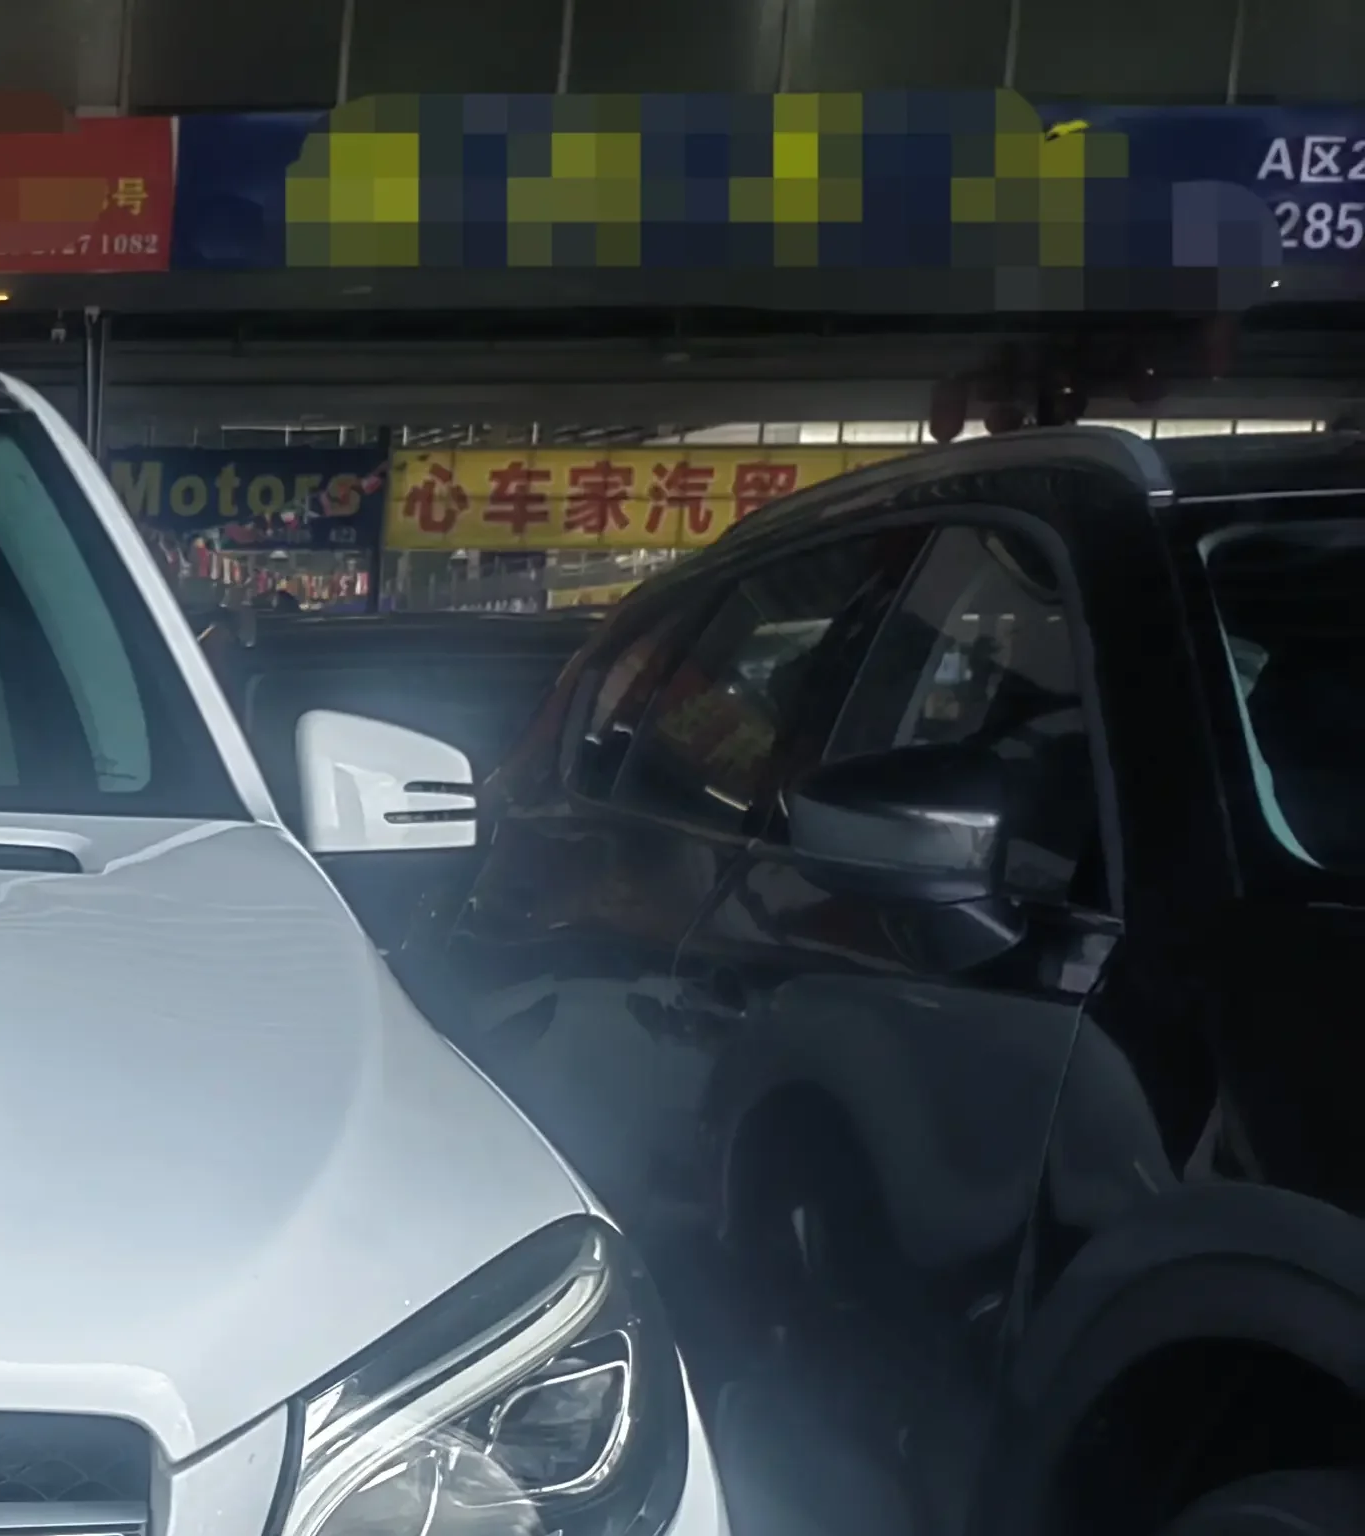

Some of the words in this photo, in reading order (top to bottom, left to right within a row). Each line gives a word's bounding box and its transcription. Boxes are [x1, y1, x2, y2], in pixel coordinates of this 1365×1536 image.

[101, 176, 150, 216] 号
[100, 233, 159, 255] 1082
[110, 460, 362, 517] Motors
